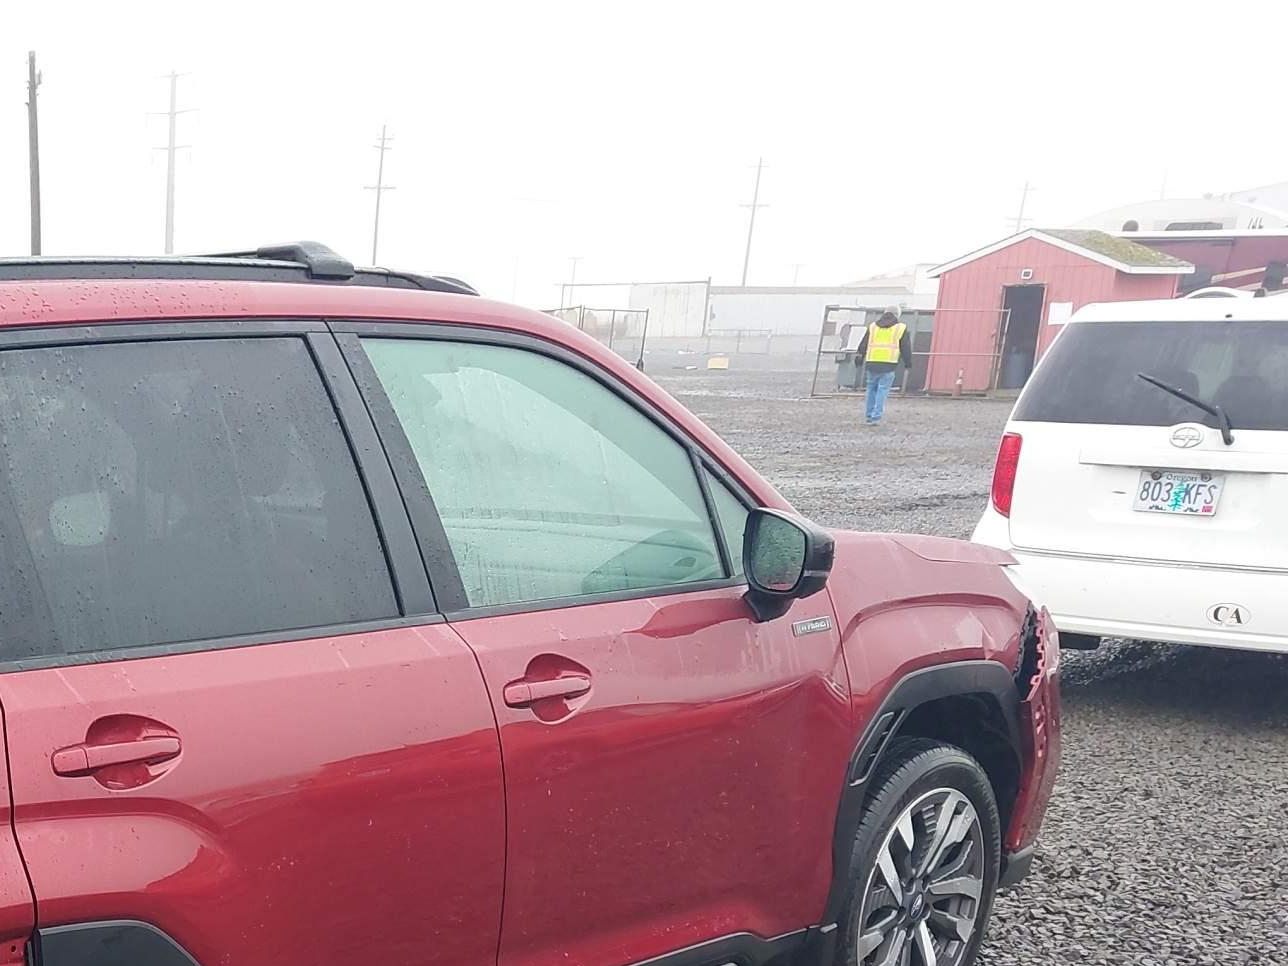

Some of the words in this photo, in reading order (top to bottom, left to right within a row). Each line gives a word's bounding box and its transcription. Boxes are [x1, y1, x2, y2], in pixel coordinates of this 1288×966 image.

[1166, 473, 1198, 482] Oregon
[1139, 481, 1173, 503] 803
[1182, 483, 1218, 505] KFS
[1212, 605, 1243, 625] CA
